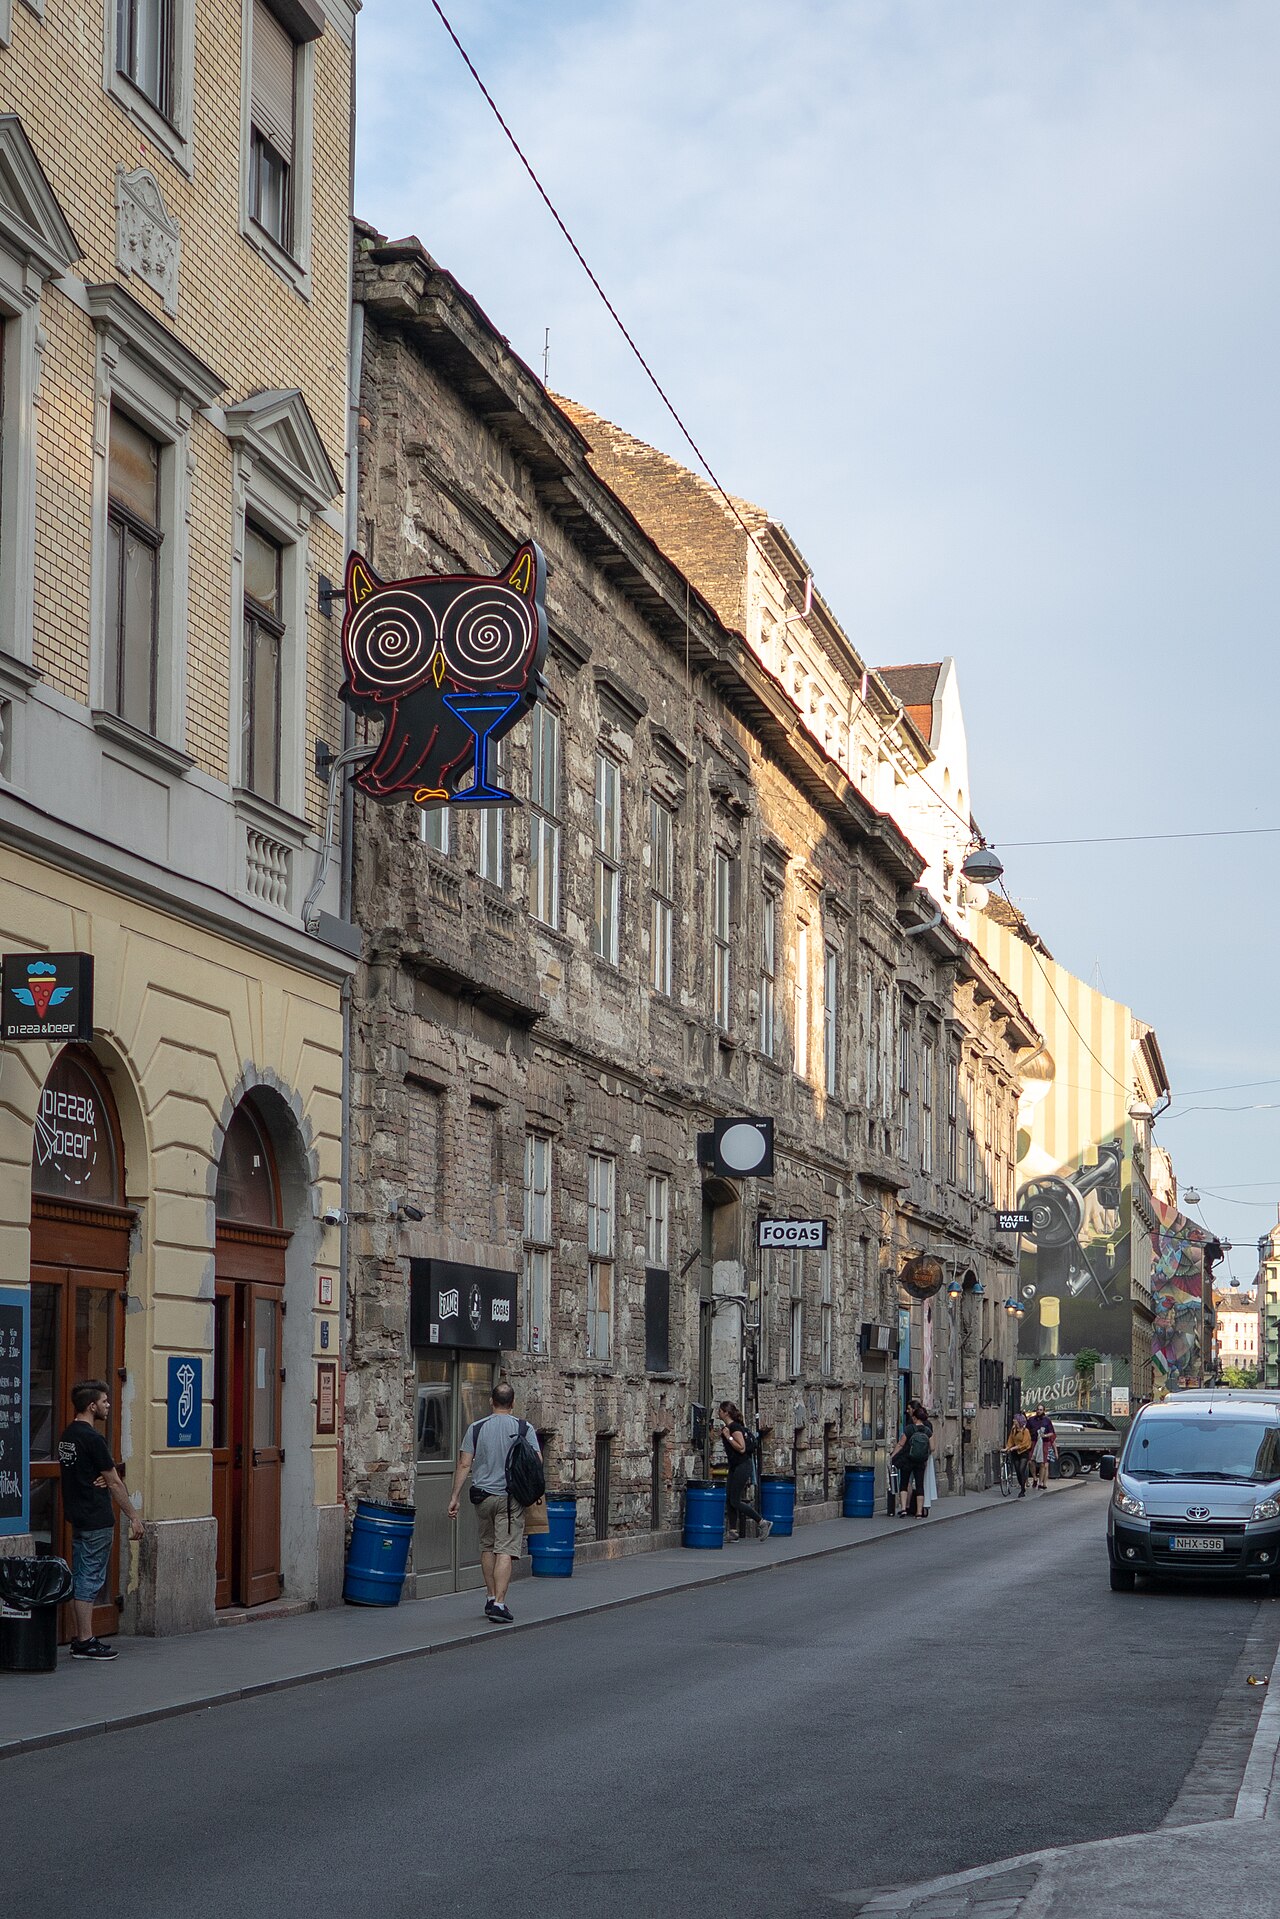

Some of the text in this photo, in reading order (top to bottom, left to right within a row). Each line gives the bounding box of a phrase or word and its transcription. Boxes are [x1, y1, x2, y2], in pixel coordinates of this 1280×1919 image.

[763, 1226, 820, 1241] FOGAS
[439, 1292, 458, 1316] FRAME
[1176, 1539, 1222, 1549] NHX-596
